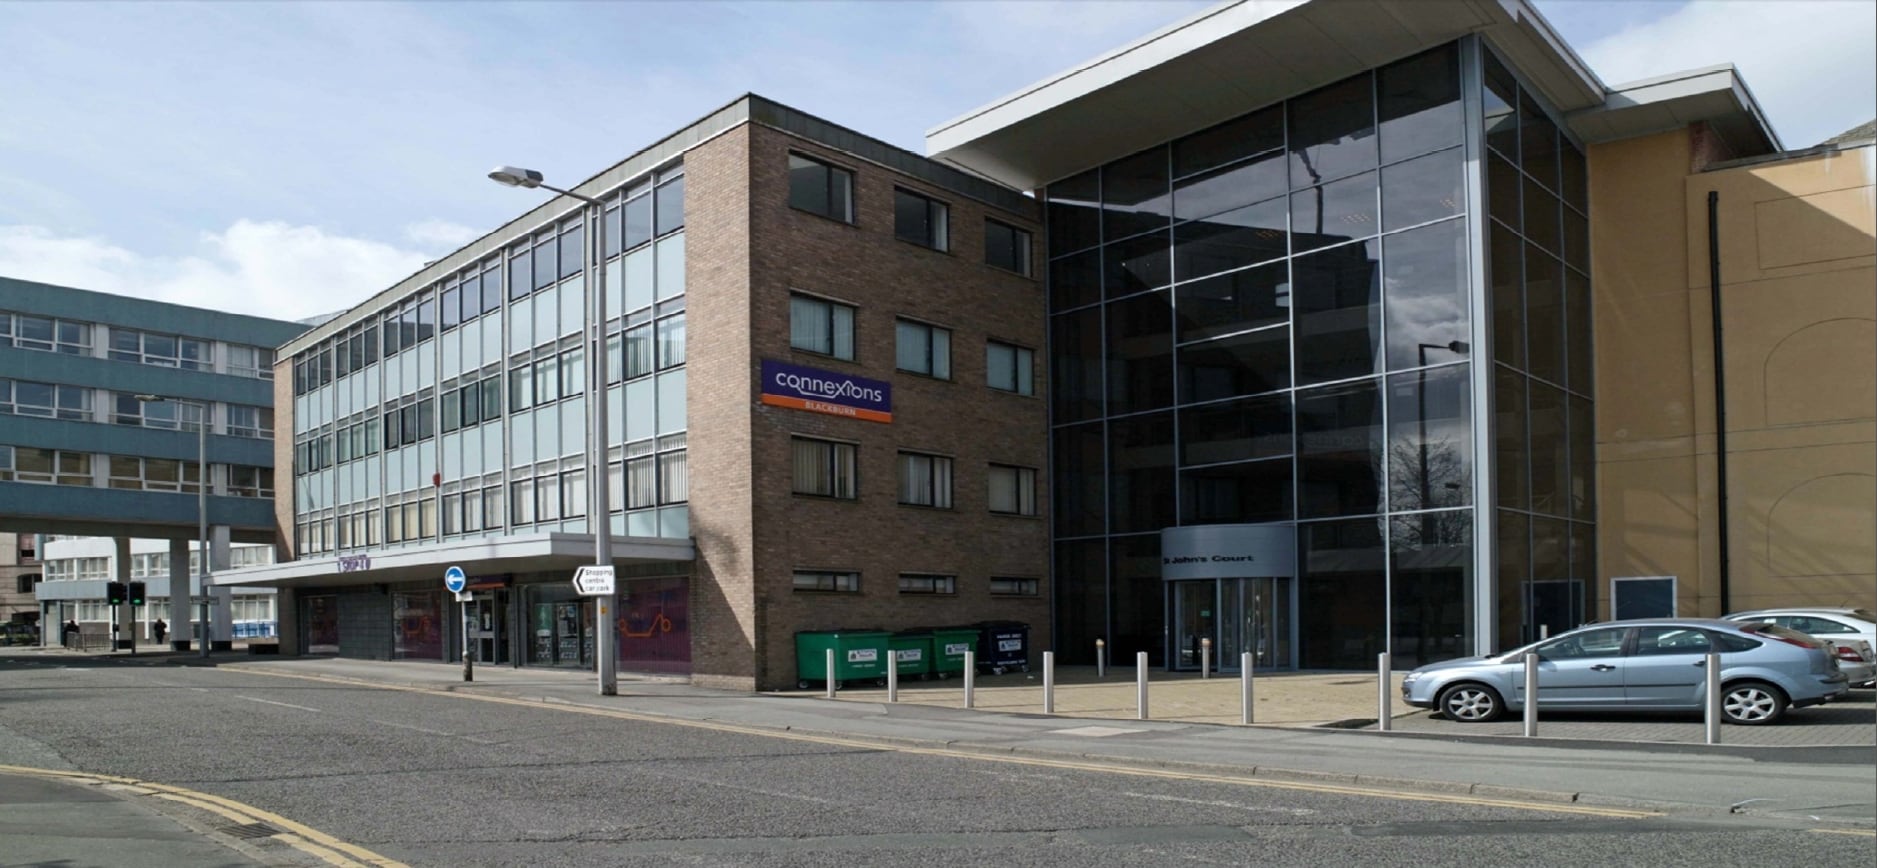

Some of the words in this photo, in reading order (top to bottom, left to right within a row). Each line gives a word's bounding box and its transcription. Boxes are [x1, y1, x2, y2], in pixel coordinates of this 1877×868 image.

[775, 373, 882, 402] connexions
[805, 401, 857, 416] BLACKBURN
[1171, 555, 1208, 564] John's
[1211, 554, 1255, 563] Court
[585, 569, 612, 577] Shopping
